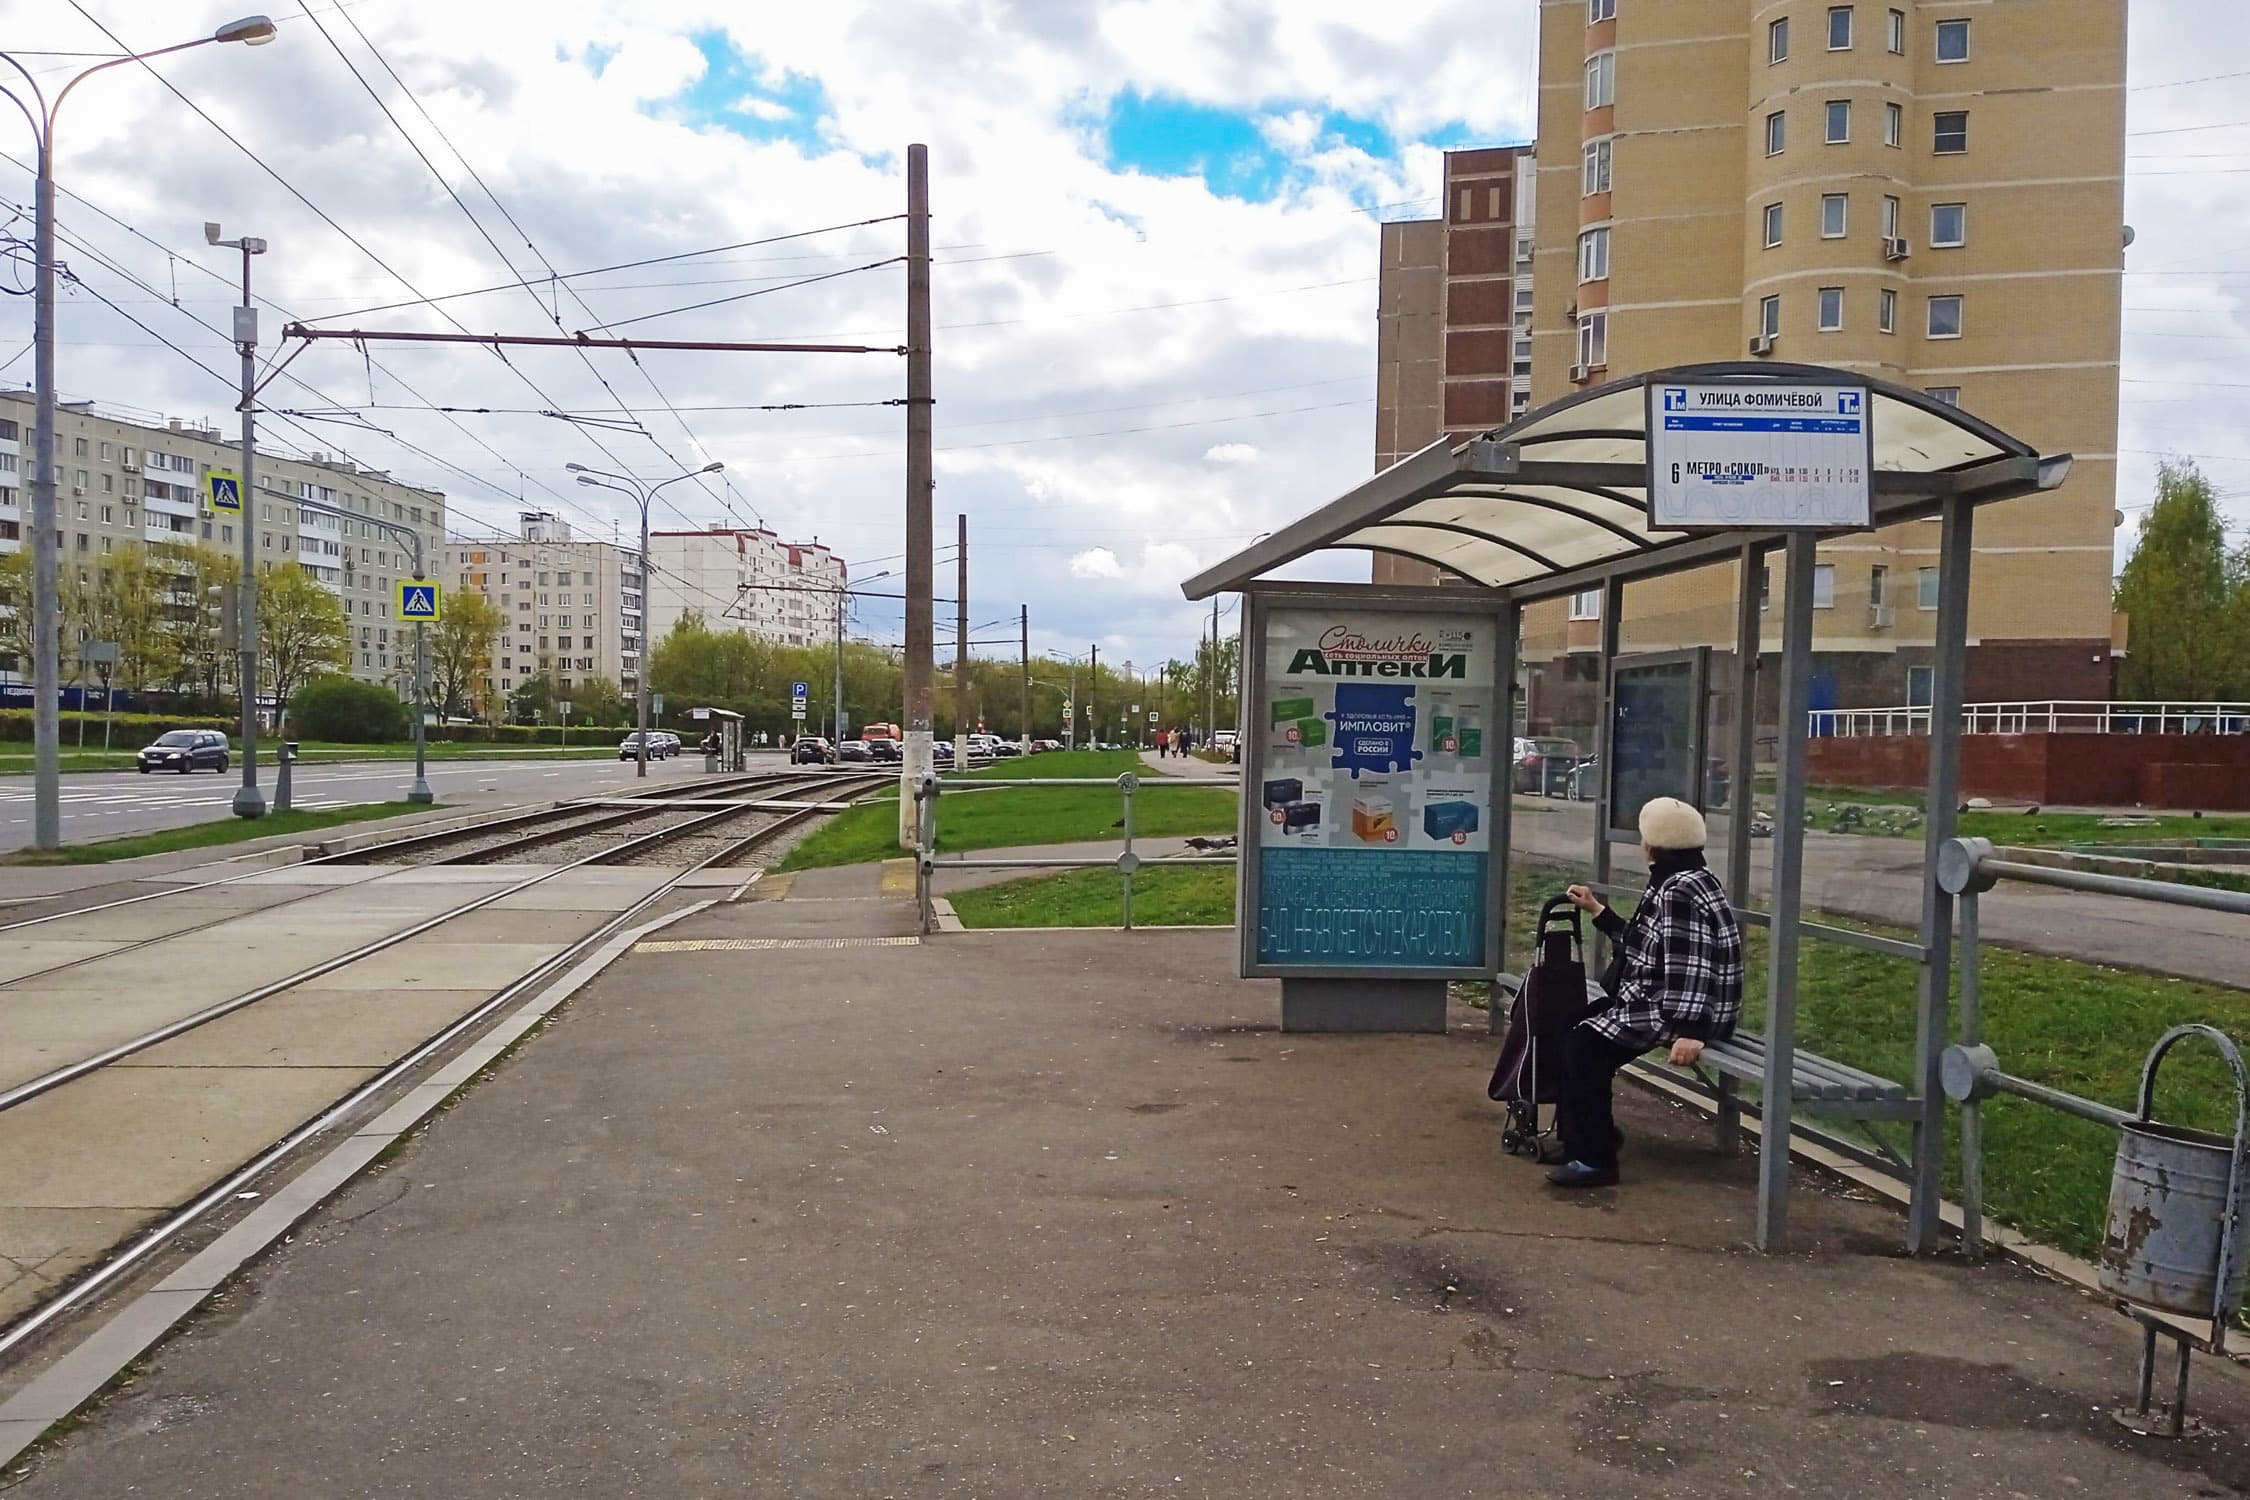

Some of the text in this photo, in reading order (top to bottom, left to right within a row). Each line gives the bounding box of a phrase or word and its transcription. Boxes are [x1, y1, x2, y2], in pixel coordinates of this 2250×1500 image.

[1699, 391, 1823, 407] УЛИЦА ФОМИЧЁВОЙ
[1671, 461, 1770, 484] 6 МЕТРО «СОКОЛ»
[1318, 625, 1437, 652] Столички
[1324, 652, 1428, 662] сеть социальных аптек
[1357, 745, 1389, 754] РОССИИ
